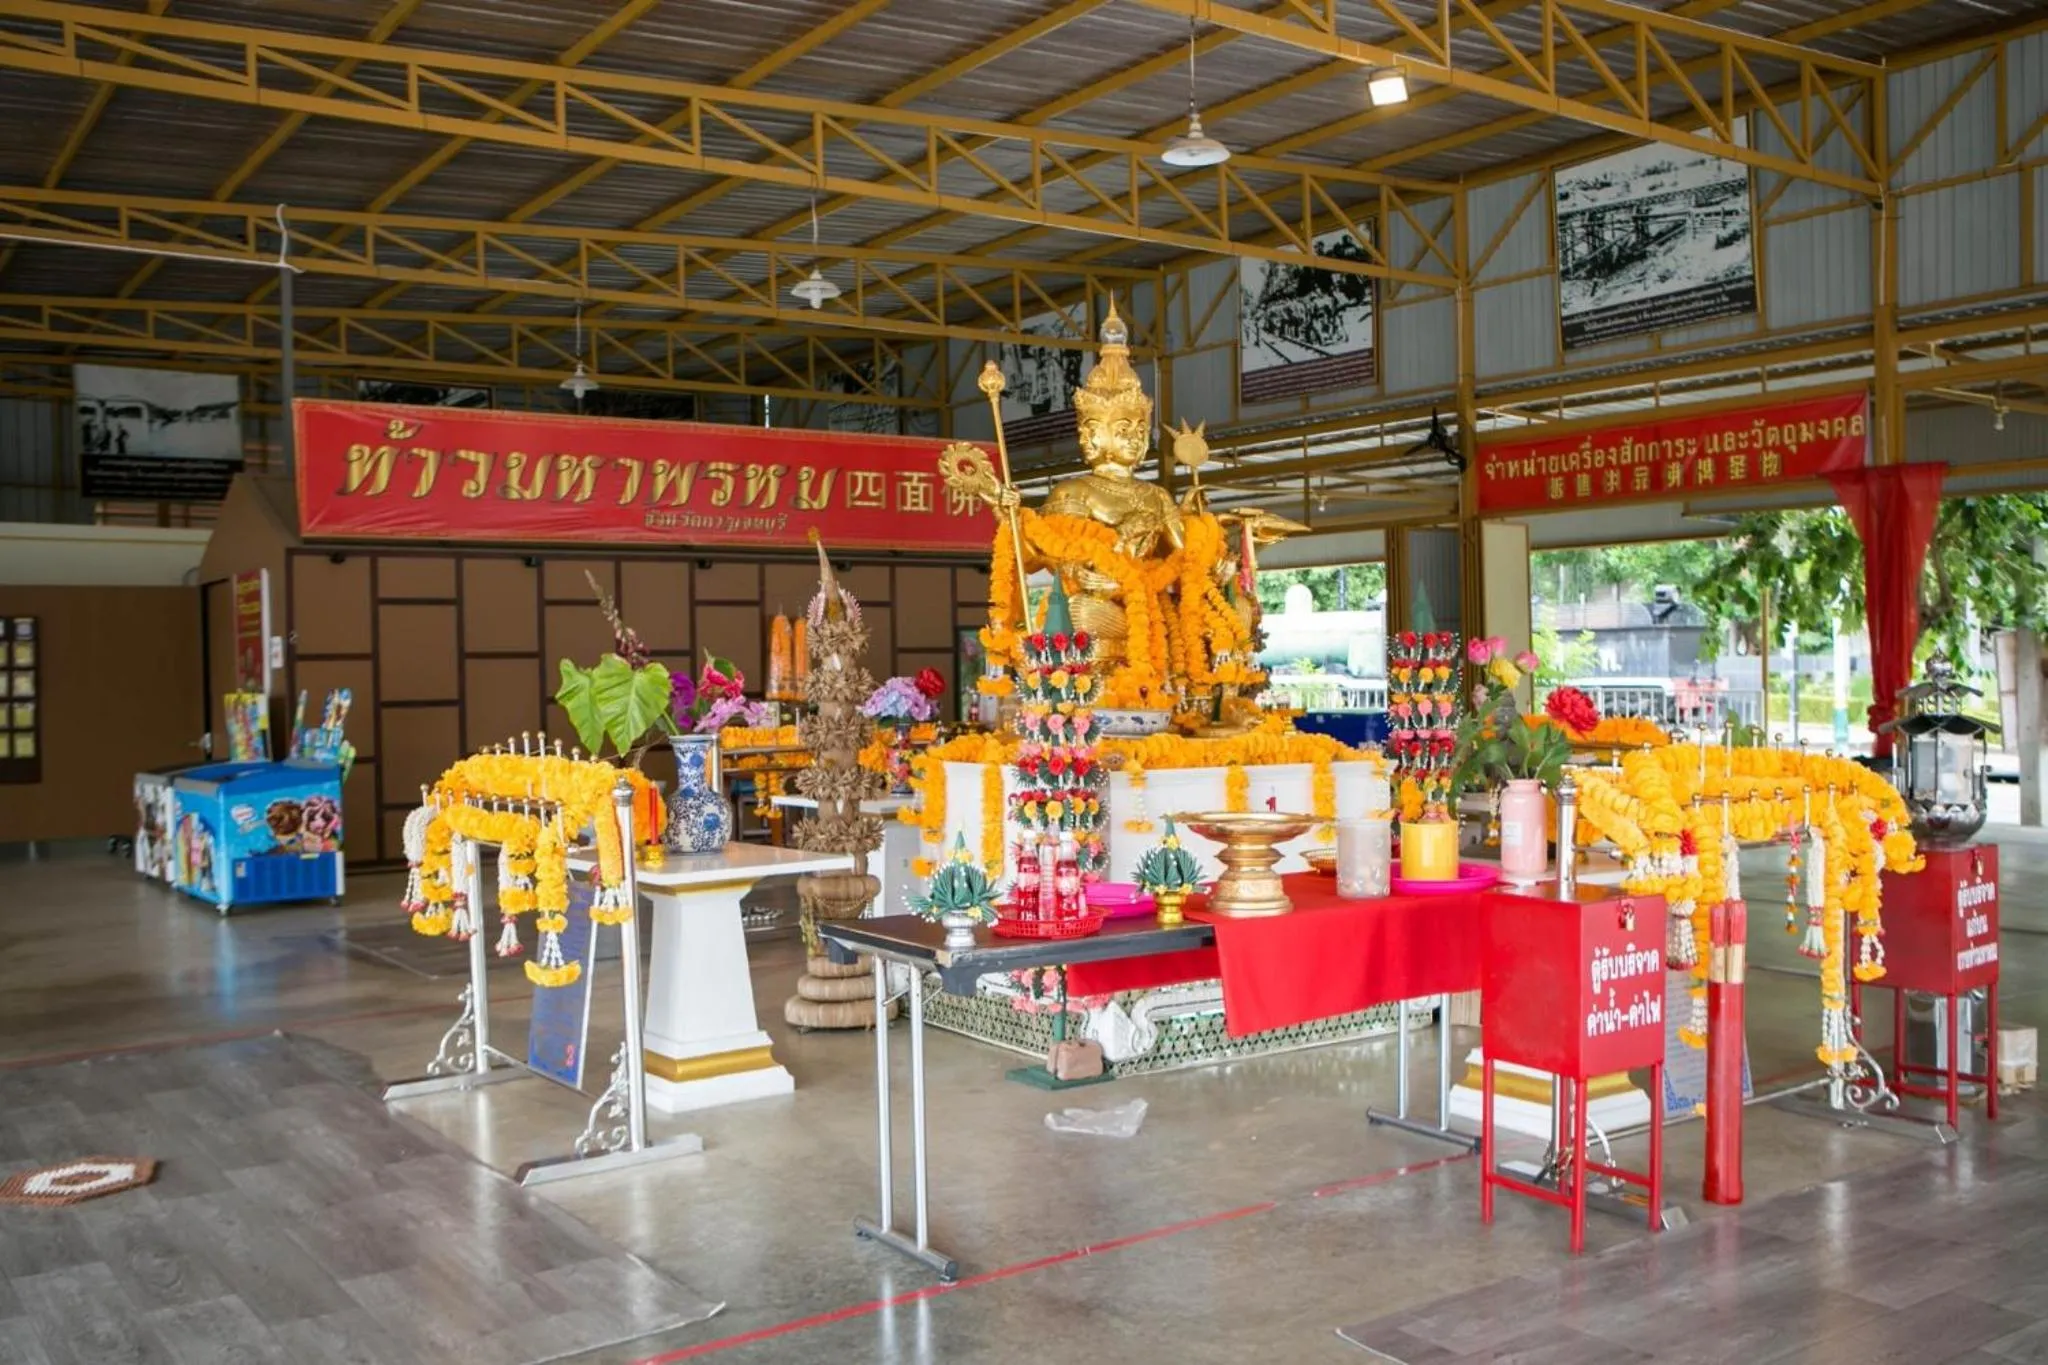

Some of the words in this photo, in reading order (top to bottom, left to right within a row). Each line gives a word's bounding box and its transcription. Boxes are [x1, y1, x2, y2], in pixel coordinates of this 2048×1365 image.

[338, 419, 839, 511] ท้าวมหาพรหม
[1592, 942, 1660, 994] ตู้รับบริจาค
[1587, 987, 1661, 1038] ค่าน้ำ-ค่าไฟ
